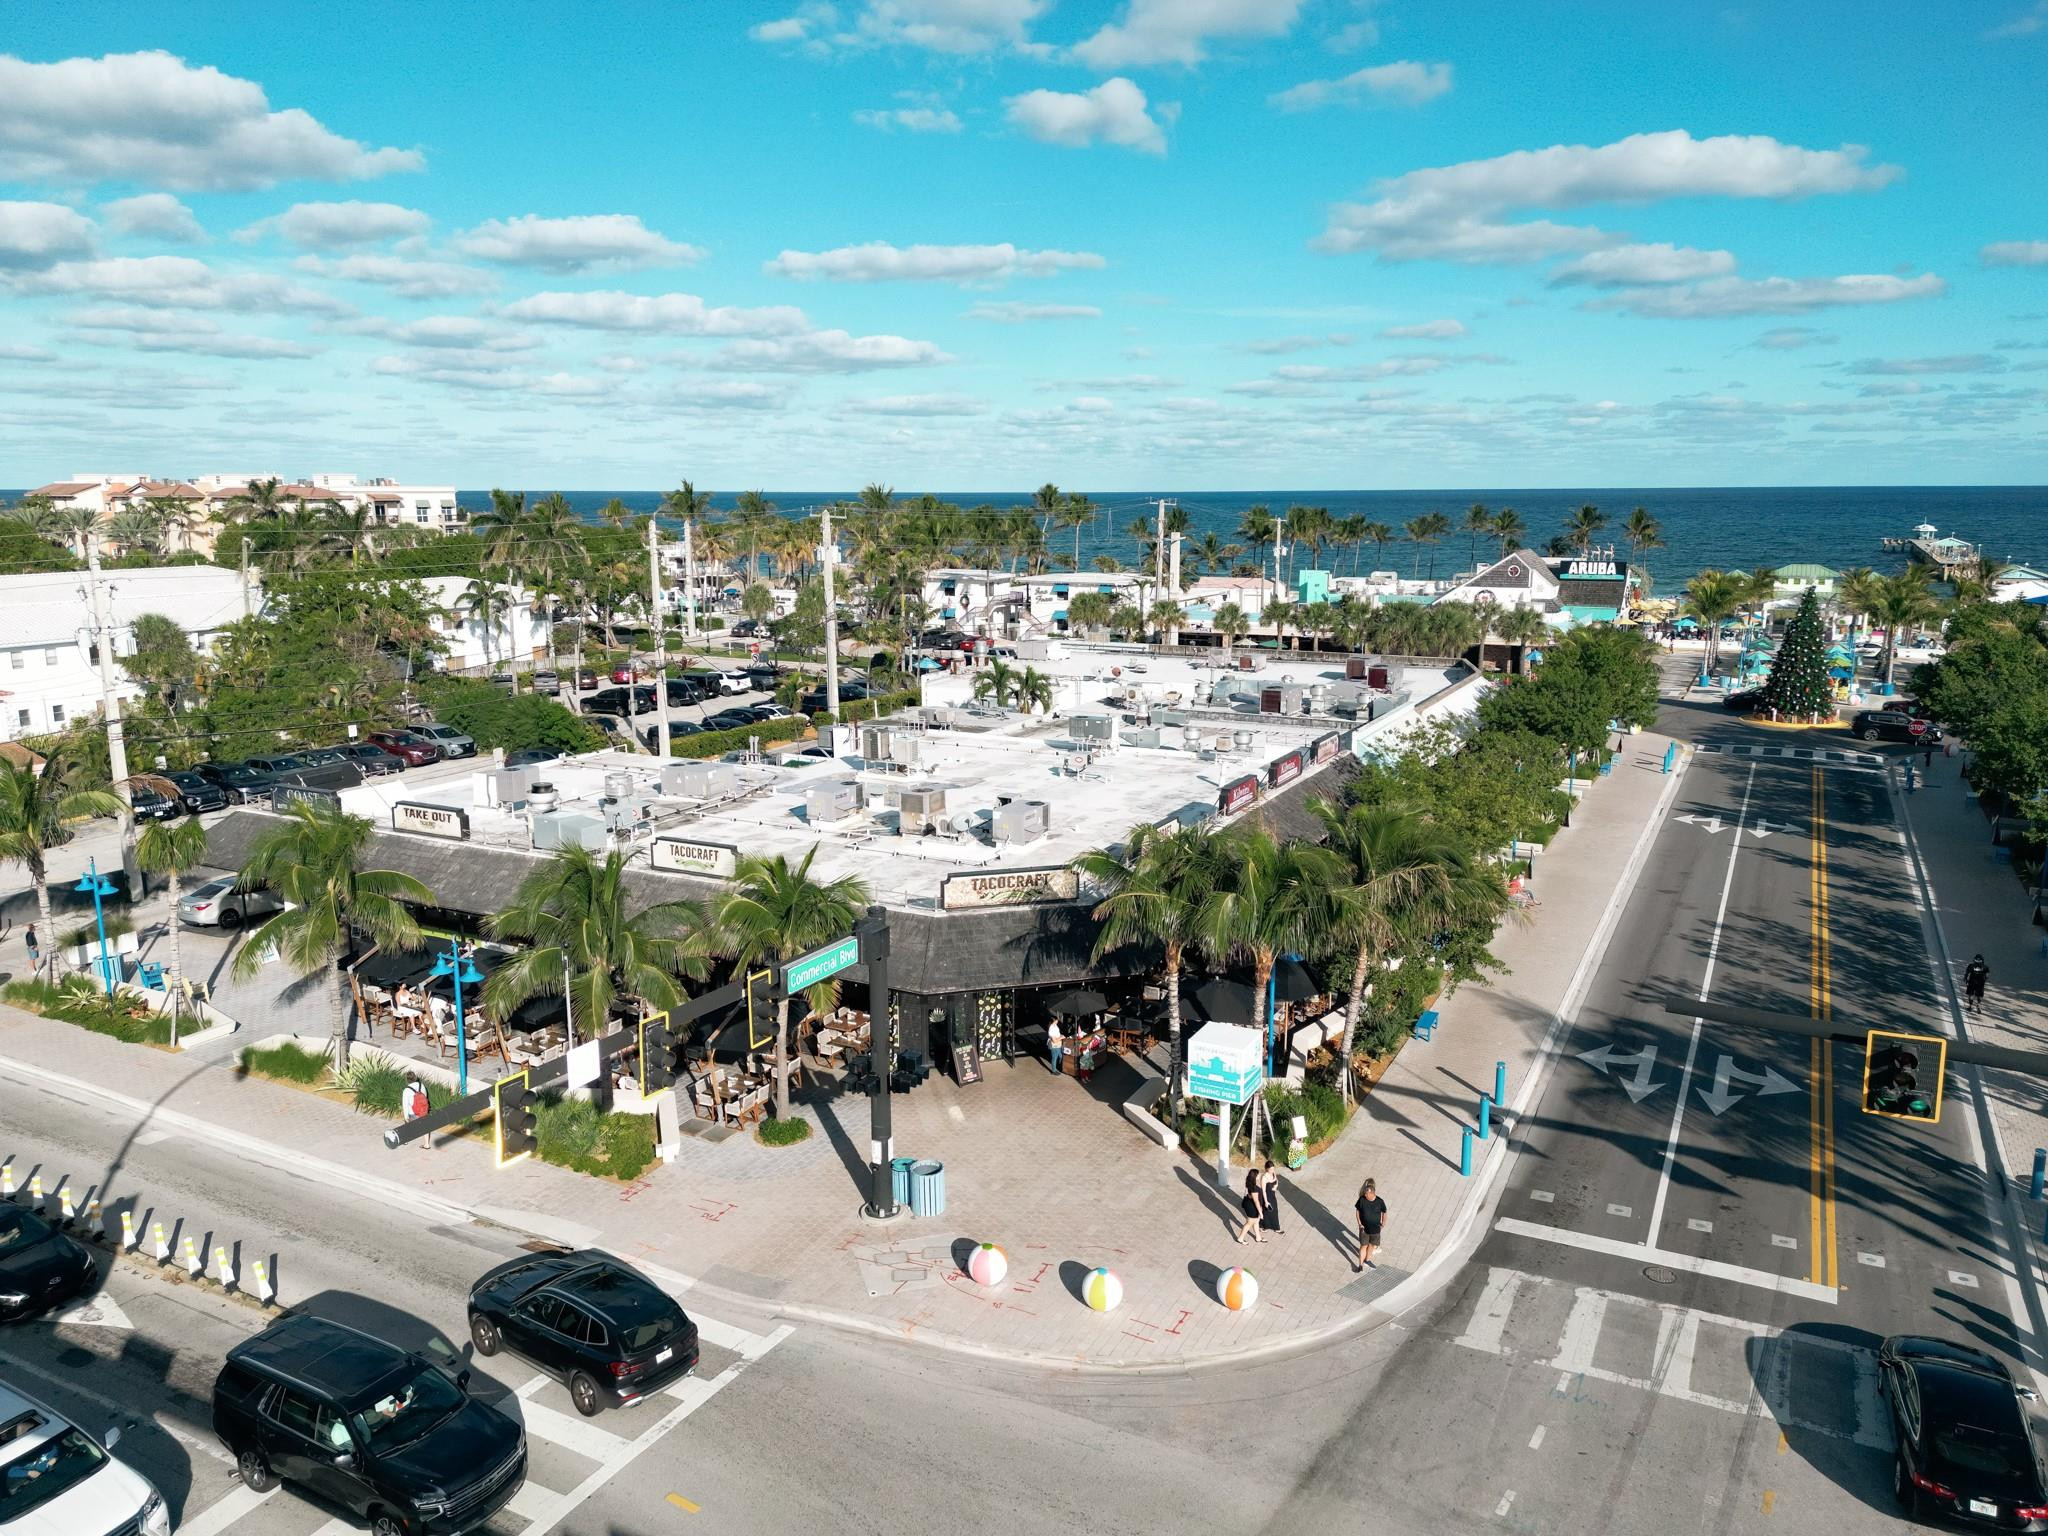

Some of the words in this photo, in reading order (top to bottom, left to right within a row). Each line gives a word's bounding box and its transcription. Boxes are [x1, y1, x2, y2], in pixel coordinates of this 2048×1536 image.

[1568, 562, 1617, 575] ARUBA
[287, 790, 320, 804] COAST
[403, 807, 429, 820] TAKE
[431, 811, 452, 823] OUT
[670, 844, 719, 862] TACOCRAFT
[971, 873, 1051, 891] TACOCRAFT
[790, 954, 837, 988] Commercial
[839, 945, 856, 965] Blvd
[1193, 1085, 1220, 1097] FISHING
[1221, 1090, 1237, 1099] PIER
